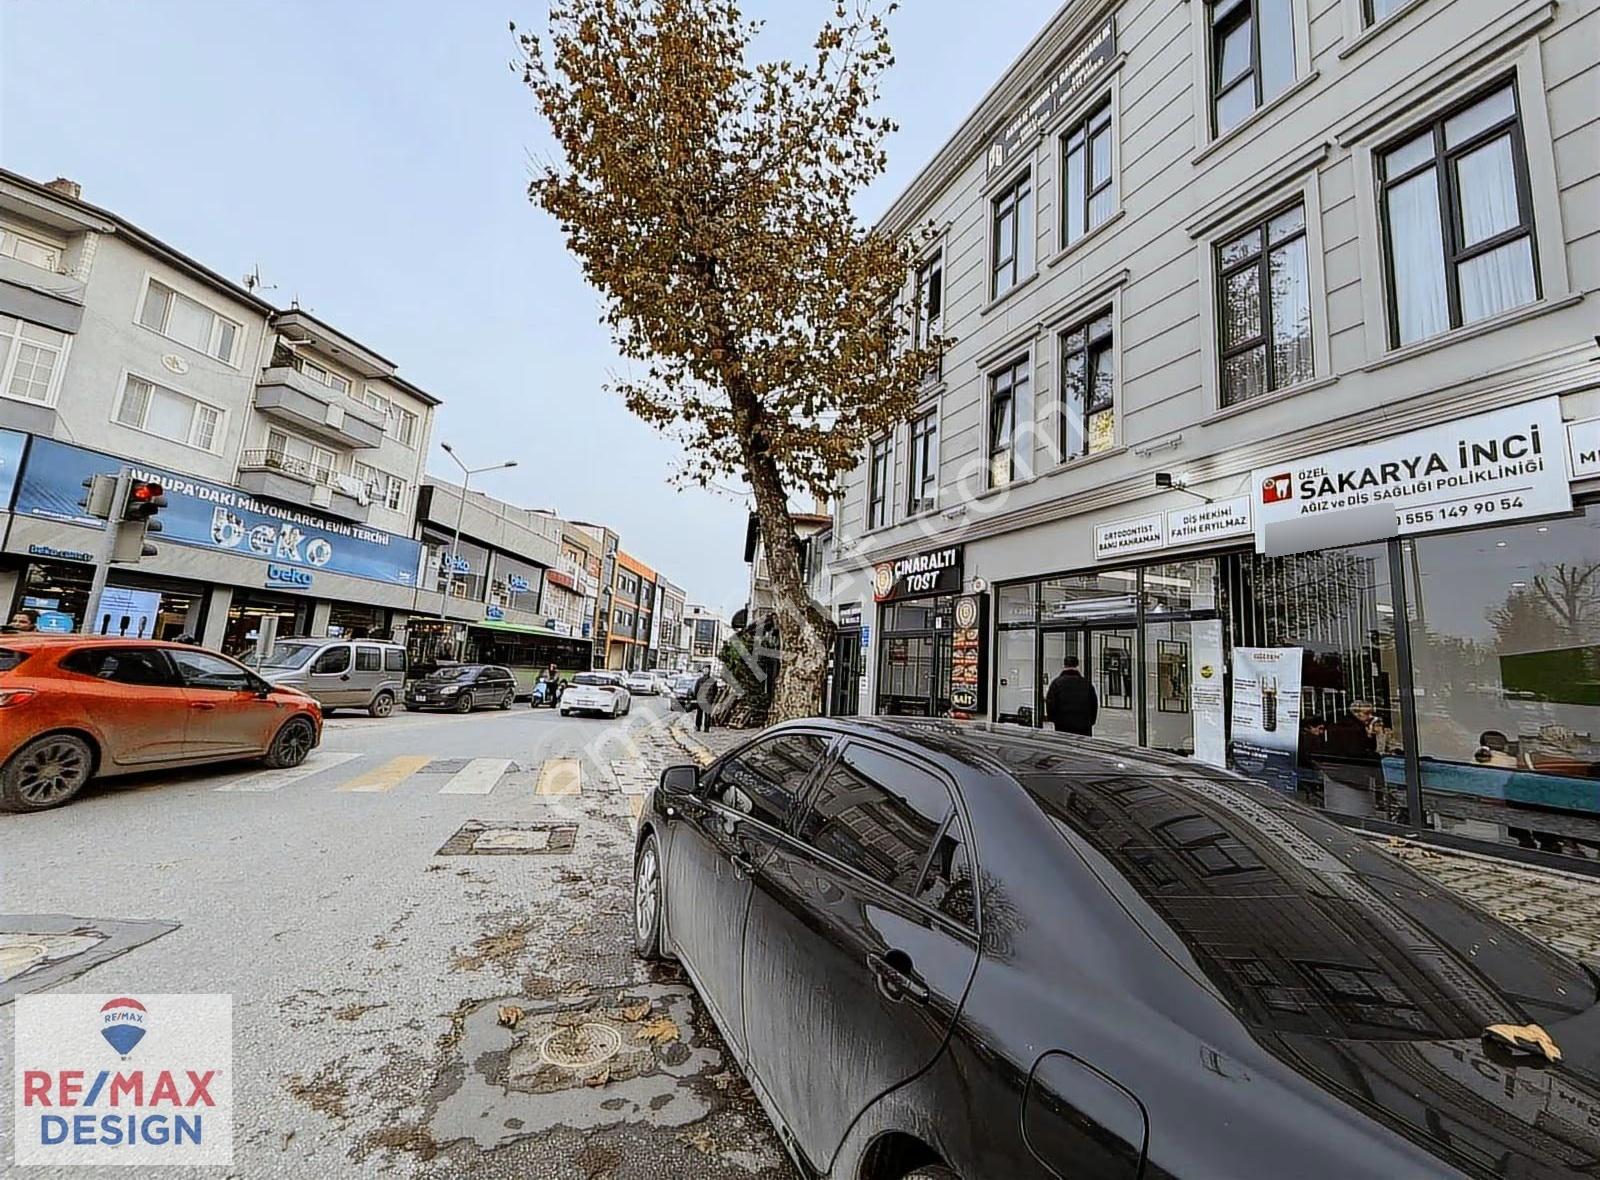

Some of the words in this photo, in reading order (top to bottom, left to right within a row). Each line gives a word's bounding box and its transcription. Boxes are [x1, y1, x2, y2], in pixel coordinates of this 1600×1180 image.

[1298, 467, 1328, 480] ÖZEL
[1300, 453, 1449, 500] SAKARYA
[1458, 424, 1542, 469] İNCİ
[1300, 500, 1329, 514] AĞIZ
[1331, 500, 1345, 509] ve
[1373, 480, 1432, 501] SAĞLIĞI
[1436, 457, 1544, 490] POLİKLİNİĞİ
[238, 497, 325, 530] MİLYONLARCA
[325, 521, 350, 536] EVİN
[1183, 514, 1198, 525] DİŞ
[1199, 506, 1232, 520] HEKİMİ
[1406, 510, 1434, 525] 555
[1439, 505, 1468, 519] 149
[1474, 501, 1495, 514] 90
[1501, 497, 1523, 510] 54
[211, 505, 332, 567] beko
[1104, 524, 1154, 541] ORTODONTİST
[1171, 525, 1197, 538] FATİH
[1199, 516, 1247, 533] ERYILMAZ
[1118, 533, 1161, 548] KAHRAMAN
[267, 563, 313, 585] beko
[894, 549, 956, 579] ÇINARALTI
[906, 570, 940, 593] TOST
